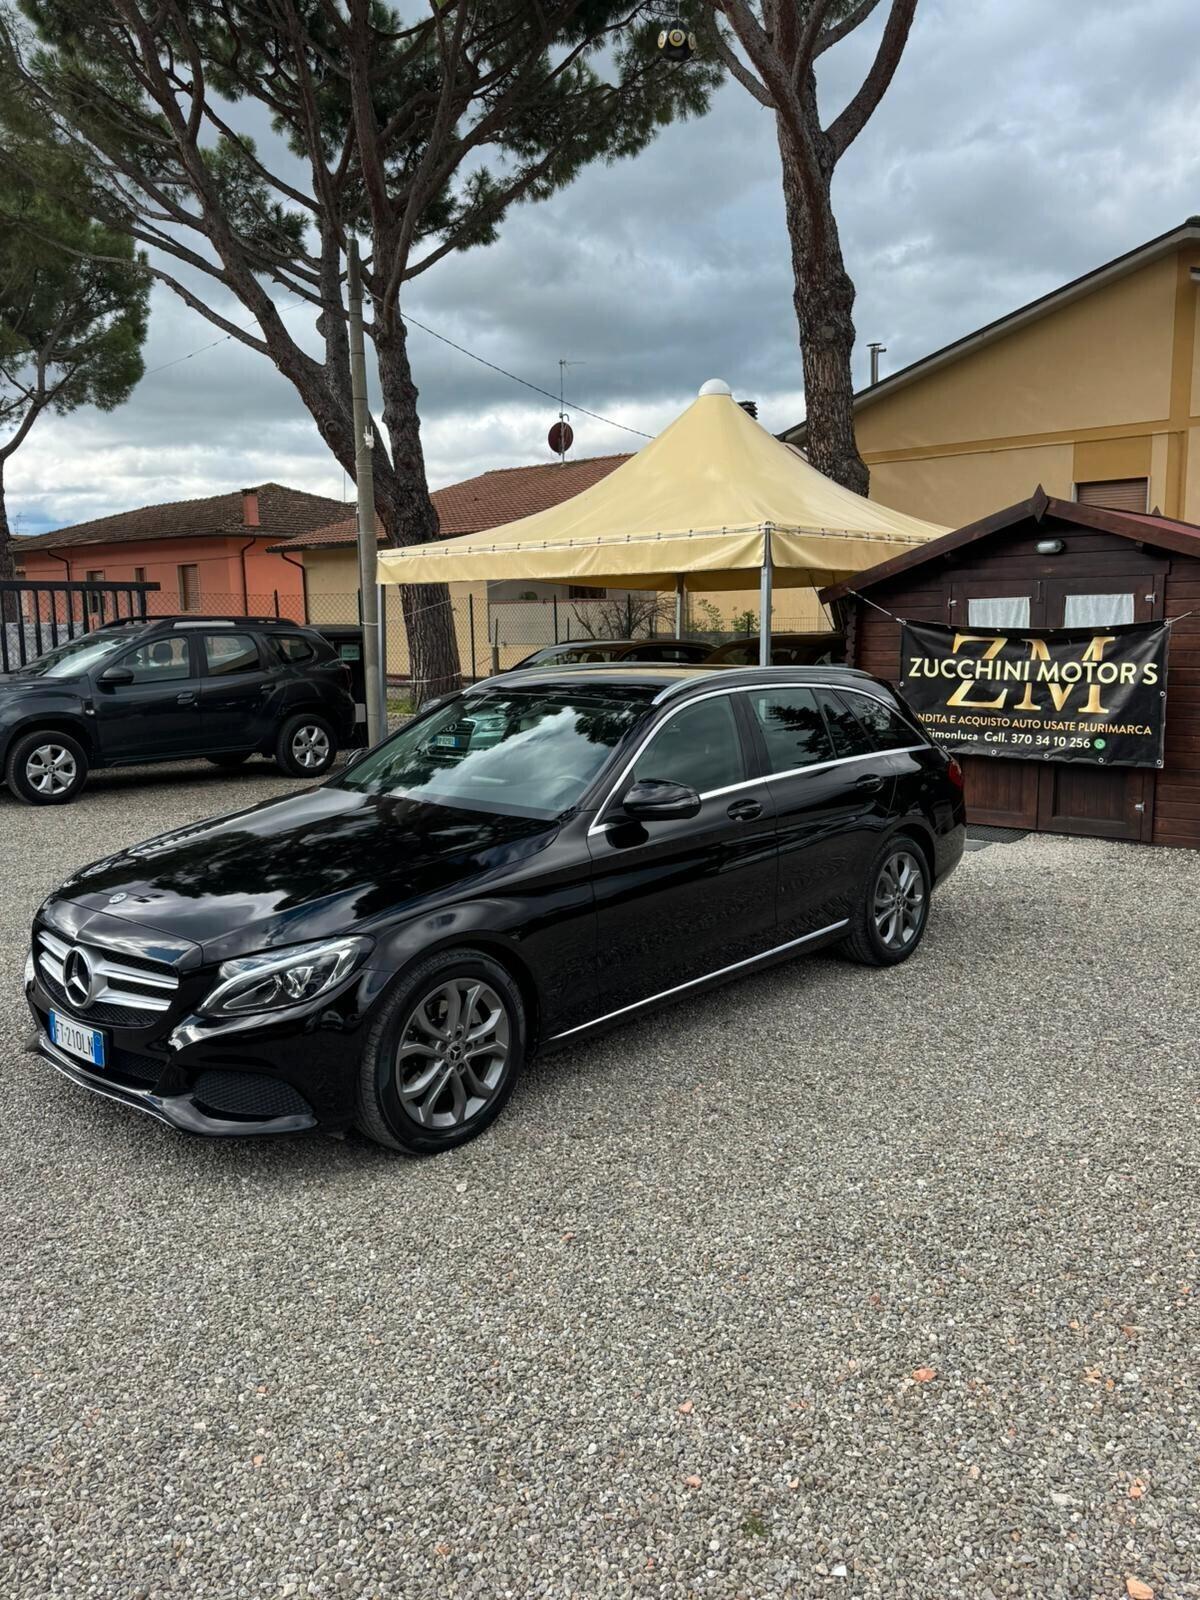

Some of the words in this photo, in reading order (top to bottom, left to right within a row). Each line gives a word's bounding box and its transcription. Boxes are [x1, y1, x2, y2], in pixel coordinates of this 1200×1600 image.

[908, 657, 1031, 682] ZUCCHINI
[917, 713, 948, 723] NDITA
[950, 715, 957, 724] E
[957, 716, 1010, 728] ACQUISTO
[1012, 719, 1041, 729] AUTO
[1043, 720, 1076, 732] USATE
[1078, 722, 1153, 735] PLURIMARCA
[984, 731, 1008, 743] Cell.
[1011, 733, 1033, 745] 370
[1035, 735, 1050, 746] 34
[1053, 736, 1067, 747] 10
[1069, 737, 1091, 749] 256
